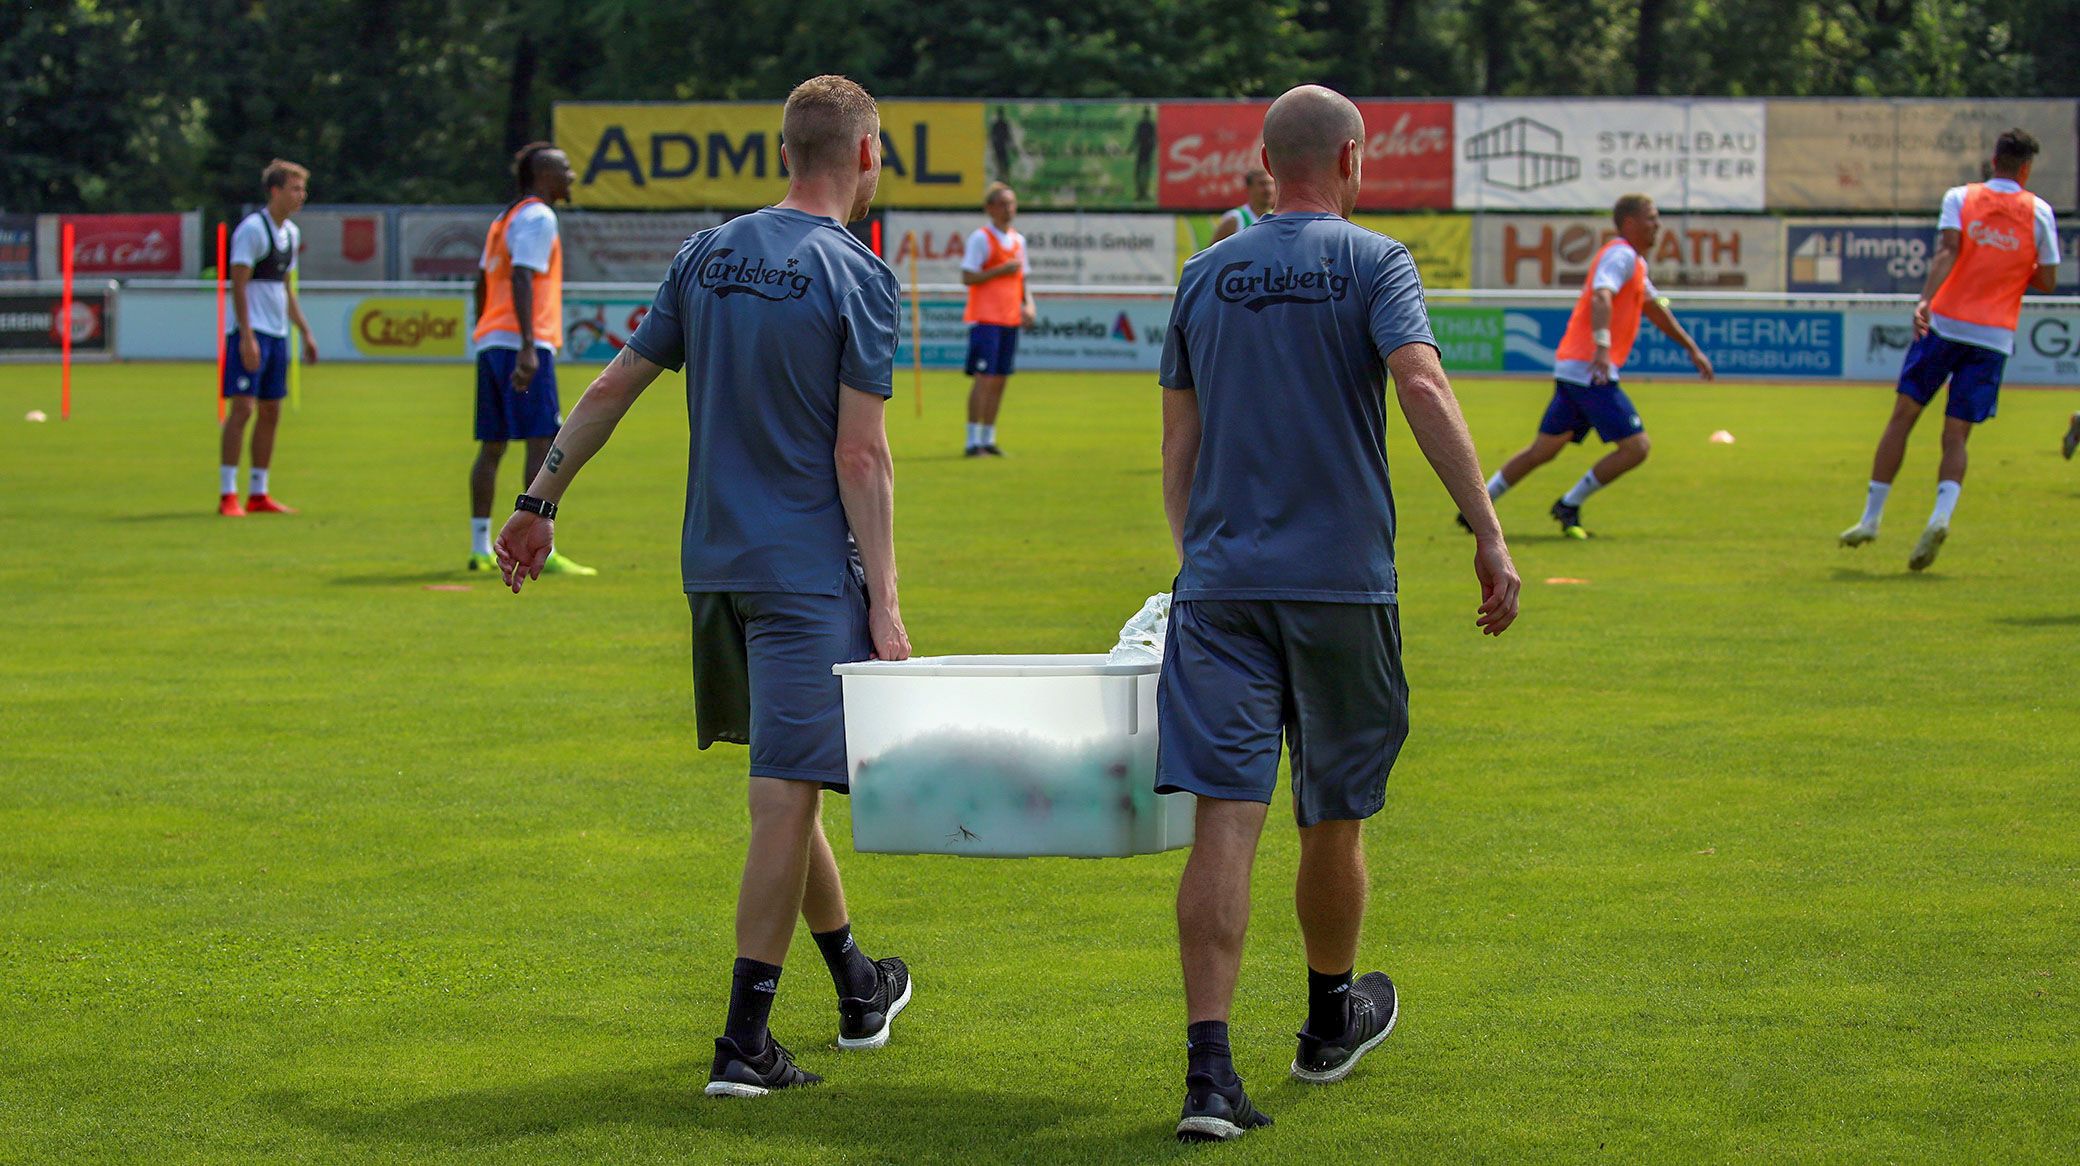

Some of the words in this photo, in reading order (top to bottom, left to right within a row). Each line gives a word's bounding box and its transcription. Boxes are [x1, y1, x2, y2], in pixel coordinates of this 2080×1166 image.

[1598, 131, 1757, 154] STAHLBAU
[1846, 231, 1926, 258] immo
[698, 248, 813, 300] Carlsberg
[1215, 260, 1349, 303] Carlsberg
